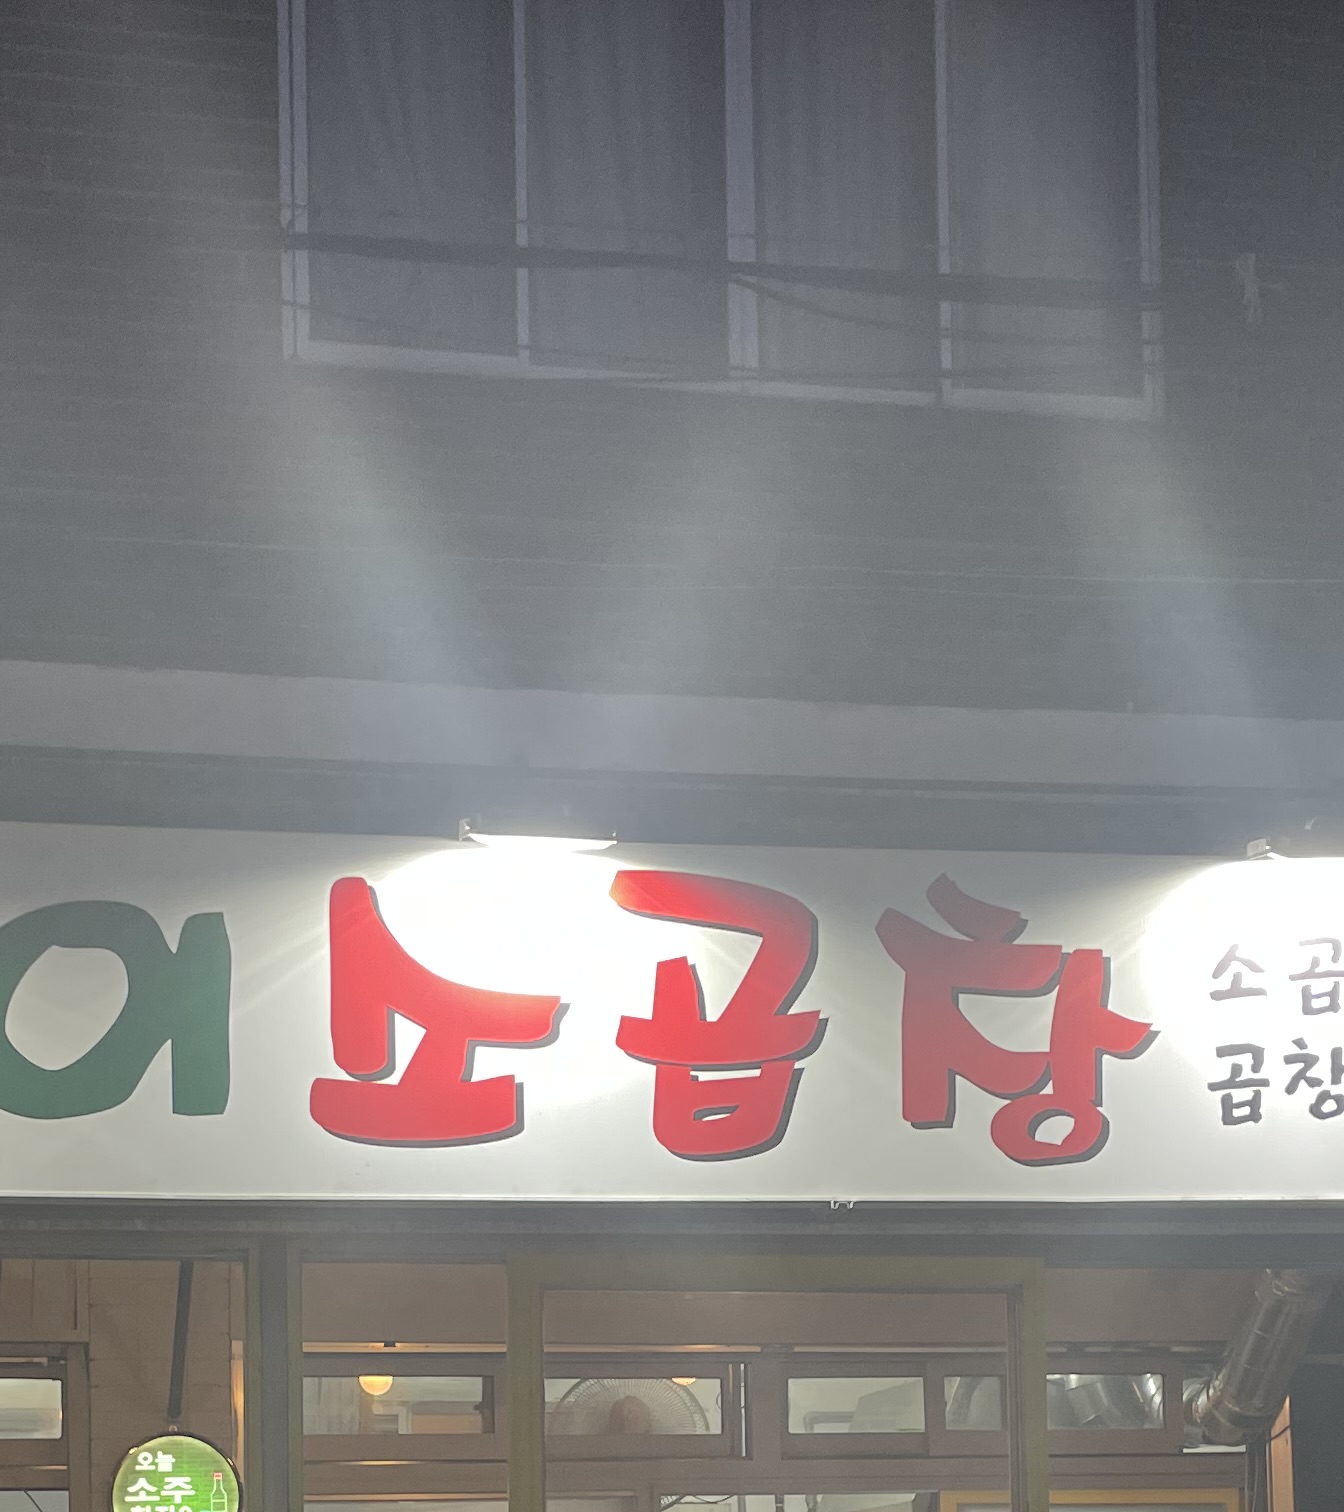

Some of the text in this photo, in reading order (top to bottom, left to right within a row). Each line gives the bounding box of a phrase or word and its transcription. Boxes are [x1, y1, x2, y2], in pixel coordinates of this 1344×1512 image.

[309, 869, 1161, 1168] 소곱창
[134, 1451, 176, 1472] 오늘
[124, 1476, 196, 1504] 소주
